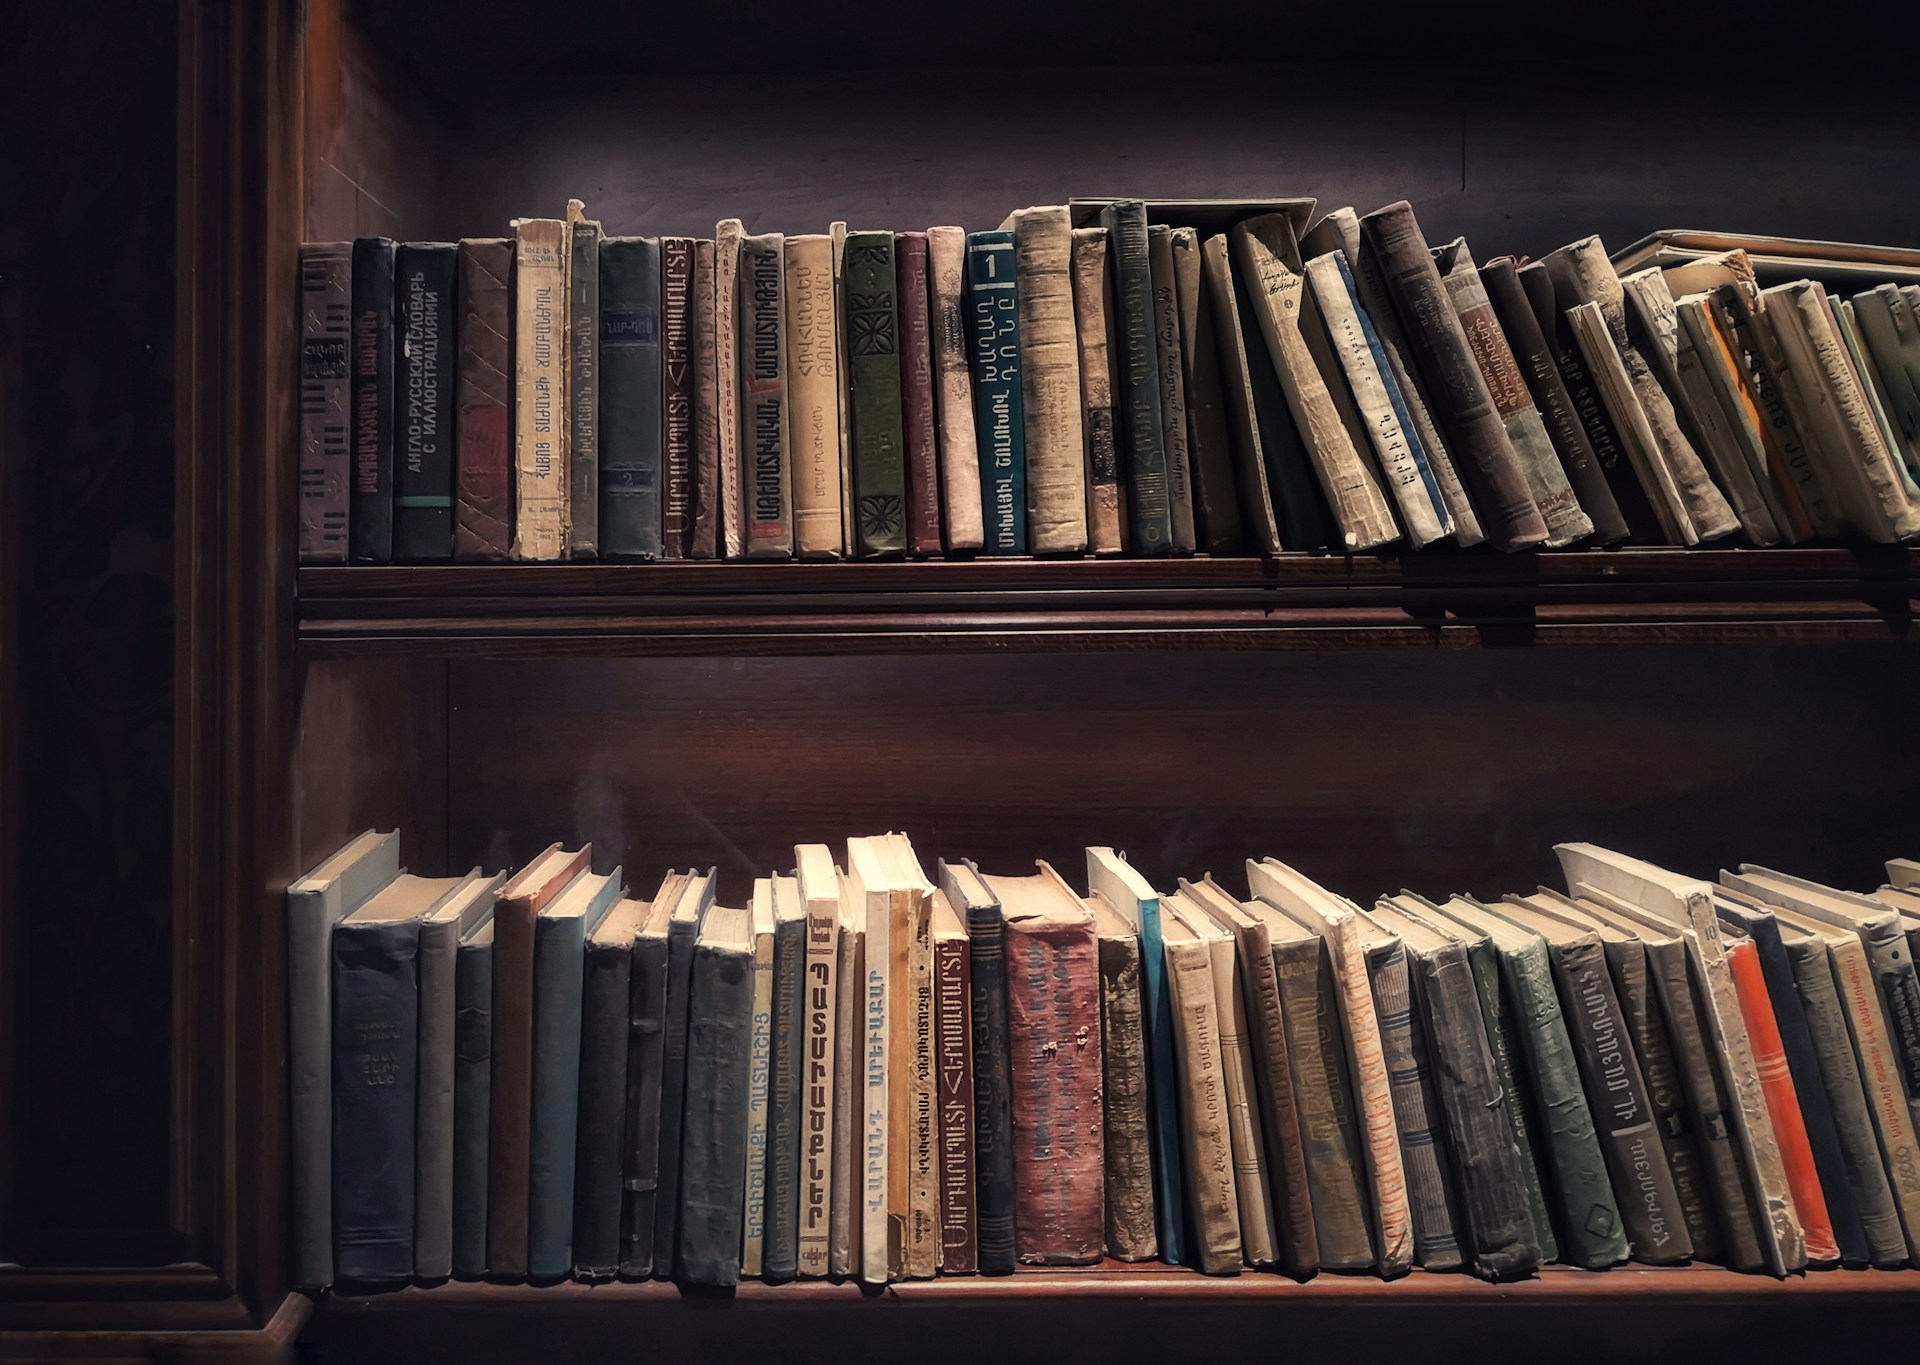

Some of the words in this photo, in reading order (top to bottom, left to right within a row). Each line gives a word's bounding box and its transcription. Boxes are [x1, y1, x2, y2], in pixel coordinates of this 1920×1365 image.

[409, 270, 424, 339] СЛОВАРЬ
[666, 238, 687, 385] ՀԵՐՈՍԱՄԱՐՏԸ
[984, 253, 996, 277] 1
[423, 290, 439, 434] ИЛЛЮСТРАЦИЯМИ
[796, 265, 815, 376] ՀՈՎՀԱՆՆԵՍ
[813, 266, 833, 377] ԹՈՒՄԱՆՅԱՆ
[976, 294, 999, 382] ԽԱՂԱՂ
[997, 296, 1019, 381] ԴՈՆԸ
[407, 343, 423, 472] АНГЛО-РУССКИЙ
[424, 443, 437, 452] С
[535, 442, 551, 479] ՀԱՅՈՑ
[990, 388, 1013, 467] ՇՈԼՈԽՈՎ
[1559, 349, 1583, 384] ՆՈՐ
[1576, 385, 1618, 470] ԿՏԱԿԱՐԱՆ
[665, 391, 688, 532] ՍԱՐԴԱՐԱՊԱՏԻ
[749, 398, 783, 539] ՄԱԹԵՄԱՏԻԿԱԿԱՆ
[996, 473, 1018, 547] ՄԻԽԱՅԻԼ
[1784, 440, 1811, 484] ՆՈՐ
[916, 985, 930, 1079] ՅԻՇԱՏԱԿԱՐԱՆ
[940, 945, 964, 1095] ՀԵՐՈՍԱՄԱՐՏԸ
[972, 987, 995, 1152] ԱԽՎԵՐԴՅԱՆ
[1195, 1004, 1212, 1070] ԾԱԳՈՒՄԸ
[1576, 968, 1630, 1092] ՄԱՅԱԿՈՎՍԿԻ
[1204, 1075, 1218, 1120] ԿՐՈՆԻ
[747, 1122, 766, 1238] ԵՐԳԻԾԱՆՔԻ
[866, 1109, 884, 1212] ՎԱՐԱՆԴ
[942, 1098, 969, 1248] ՍԱՐԴԱՐԱՊԱՏԻ
